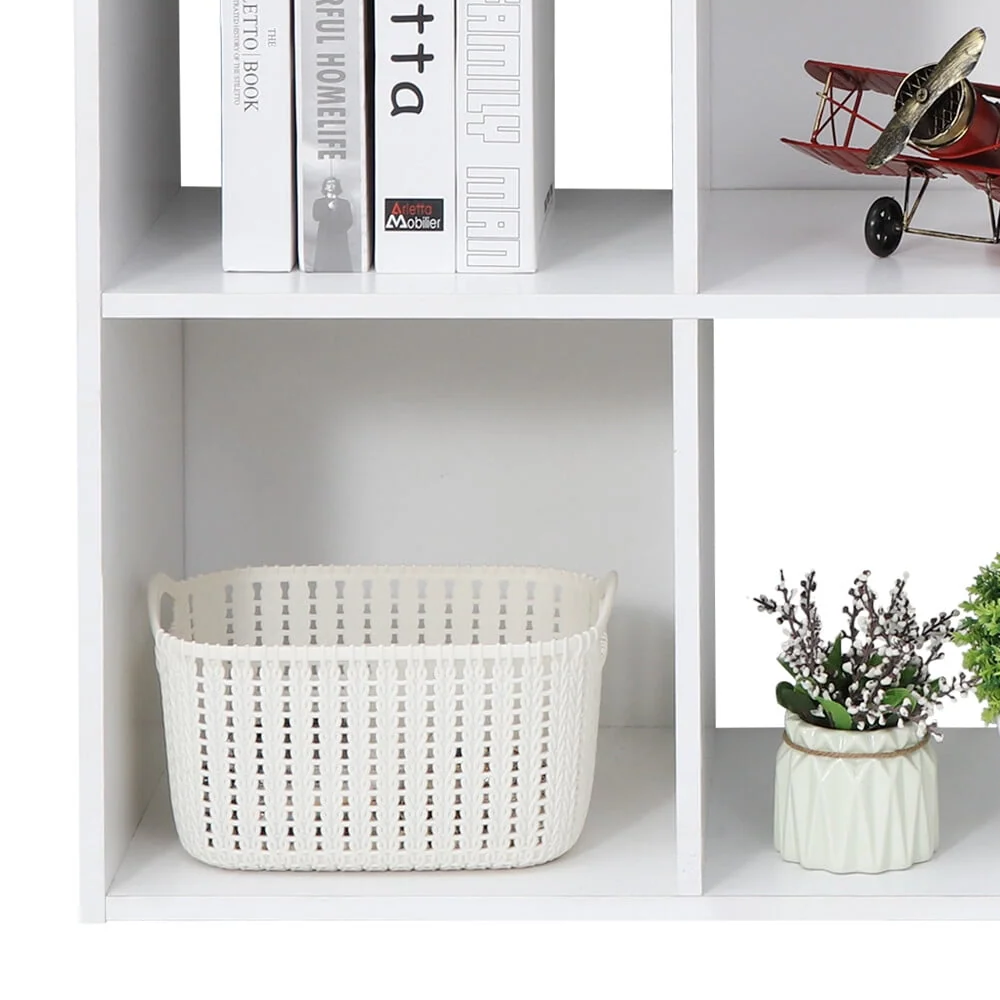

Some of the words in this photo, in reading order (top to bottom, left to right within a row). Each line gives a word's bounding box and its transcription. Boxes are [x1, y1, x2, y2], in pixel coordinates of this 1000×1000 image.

[267, 28, 276, 47] THE
[243, 61, 259, 113] BOOK
[316, 53, 347, 160] HOMELIFE
[465, 166, 521, 268] MAN
